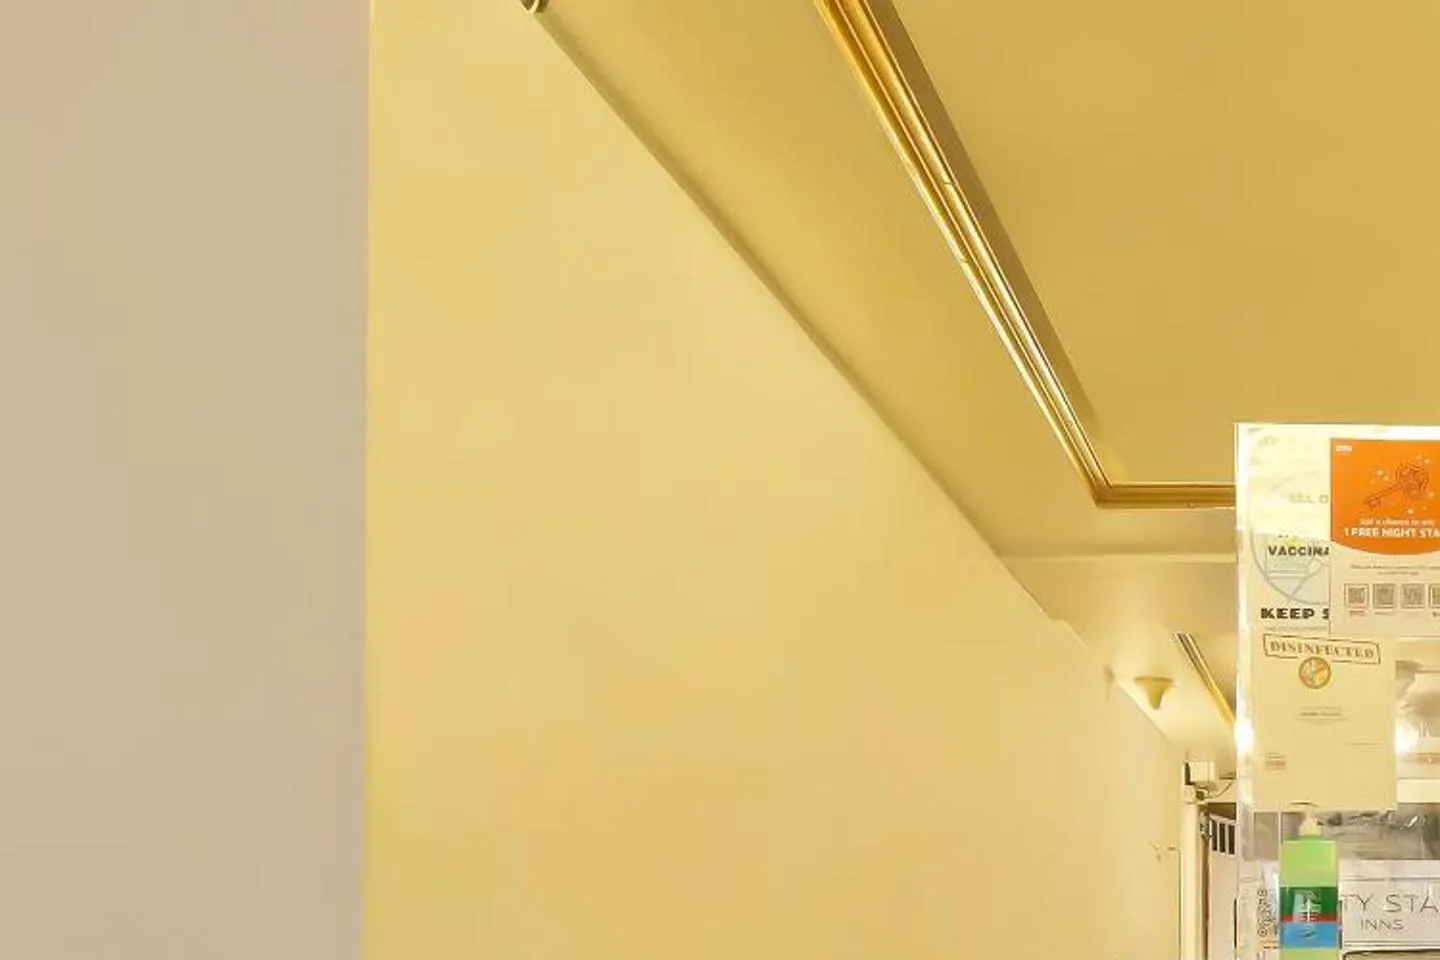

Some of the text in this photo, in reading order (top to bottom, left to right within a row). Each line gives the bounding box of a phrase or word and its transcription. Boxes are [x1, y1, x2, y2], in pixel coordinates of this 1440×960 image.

[1344, 527, 1349, 537] 1
[1351, 527, 1379, 537] FREE
[1382, 527, 1417, 538] NIGHT
[1261, 608, 1314, 619] KEEP
[1270, 641, 1374, 658] DISINFECTED
[1361, 919, 1404, 930] INNS
